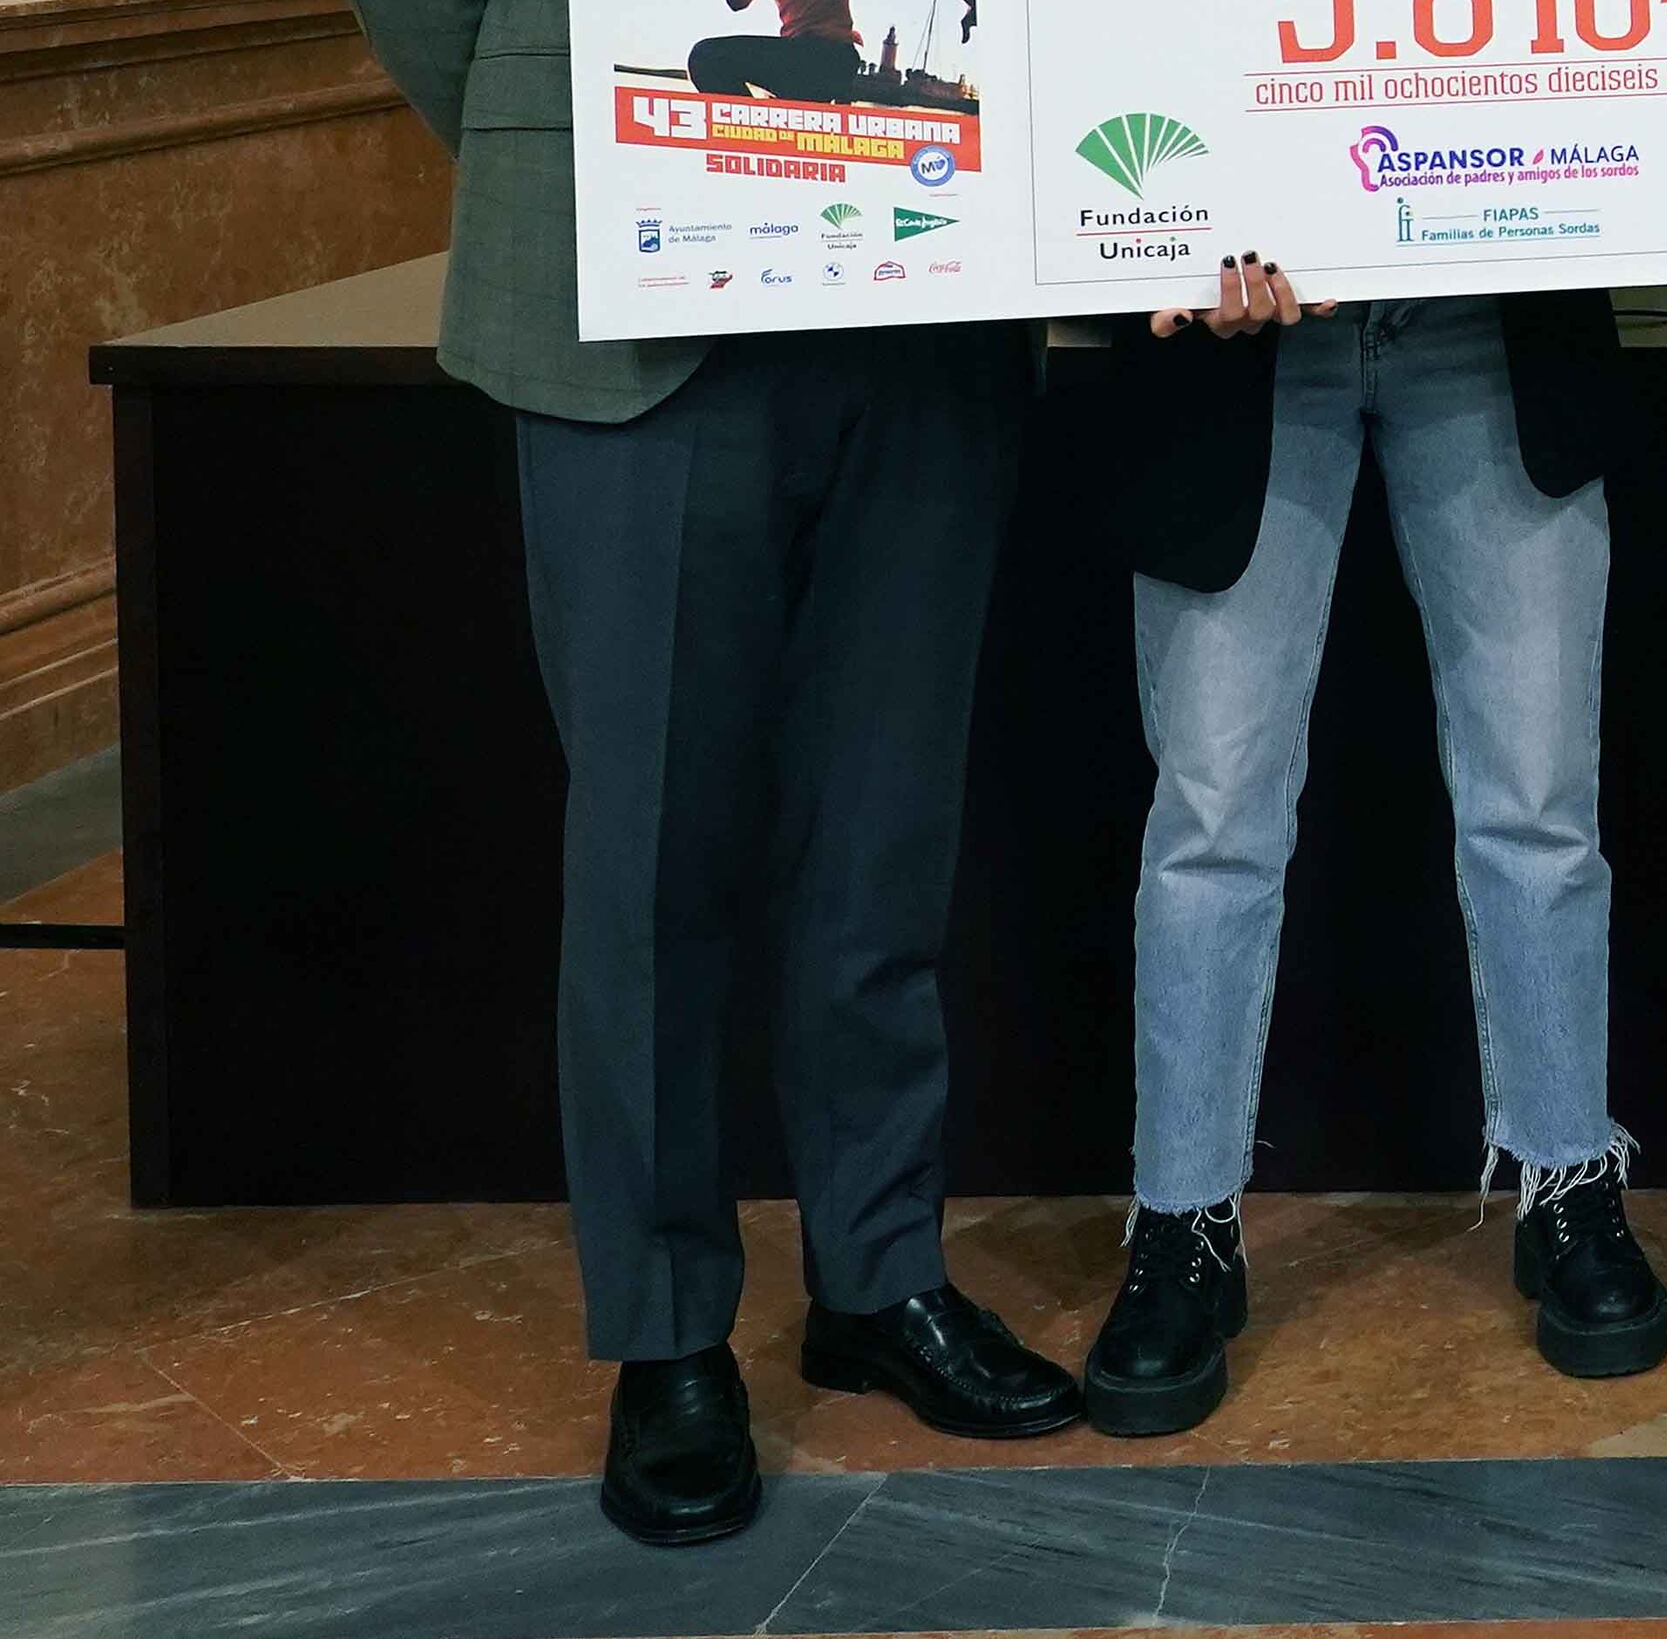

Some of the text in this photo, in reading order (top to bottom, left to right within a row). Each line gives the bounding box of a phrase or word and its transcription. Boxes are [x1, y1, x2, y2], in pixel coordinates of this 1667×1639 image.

[1256, 77, 1323, 105] cinco
[1335, 75, 1374, 102] mil
[1384, 68, 1538, 100] ochocientos
[1548, 63, 1658, 93] dieciseis
[633, 96, 960, 145] 43 CARRERA URBANA
[706, 154, 846, 183] SOLIDARIA
[1377, 144, 1640, 173] ASPANSOR MÁLAGA
[1380, 163, 1640, 188] Asociación de padres y amigos de los sordos
[1080, 205, 1209, 227] Fundación
[1483, 208, 1539, 222] FIAPAS
[1422, 222, 1600, 241] Familias de Personas Sordas
[1100, 236, 1190, 261] Unicaja
